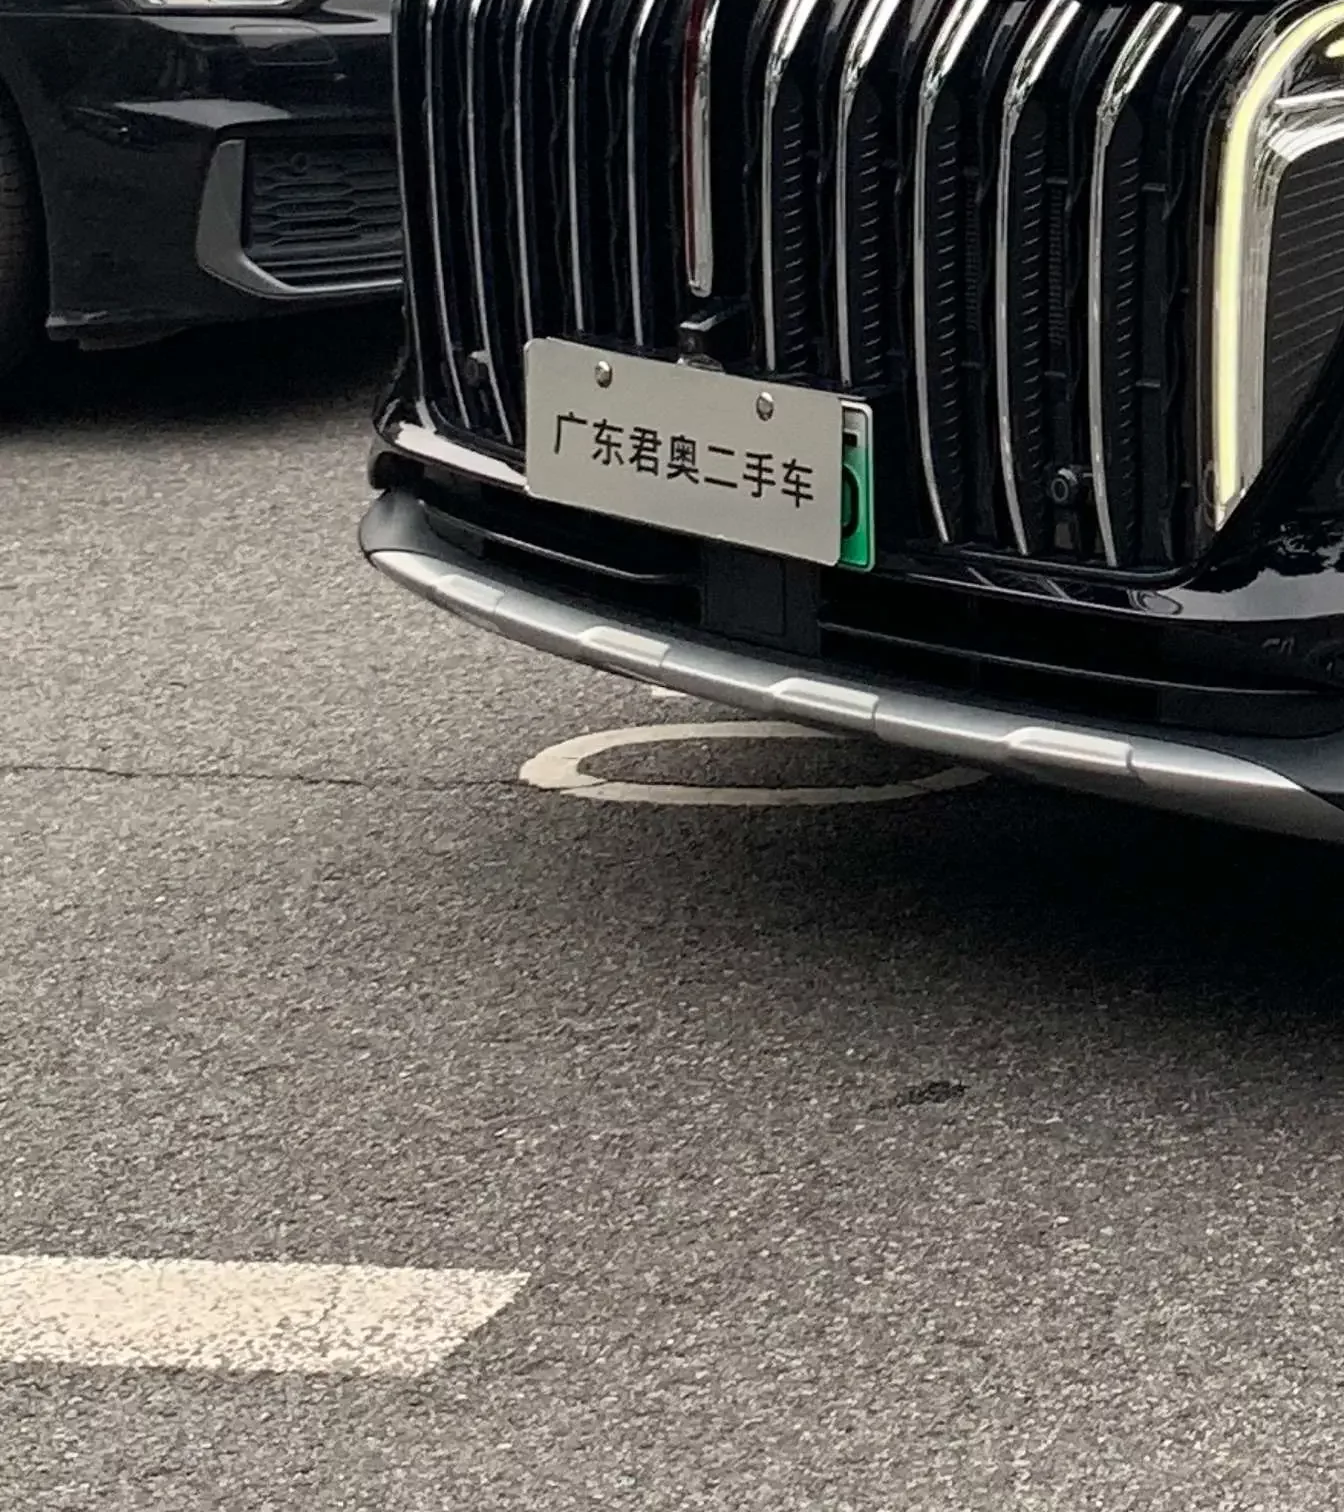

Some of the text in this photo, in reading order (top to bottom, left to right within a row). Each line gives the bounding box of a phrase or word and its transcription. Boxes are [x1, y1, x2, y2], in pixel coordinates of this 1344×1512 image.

[553, 410, 814, 509] 广东君奥二手车
